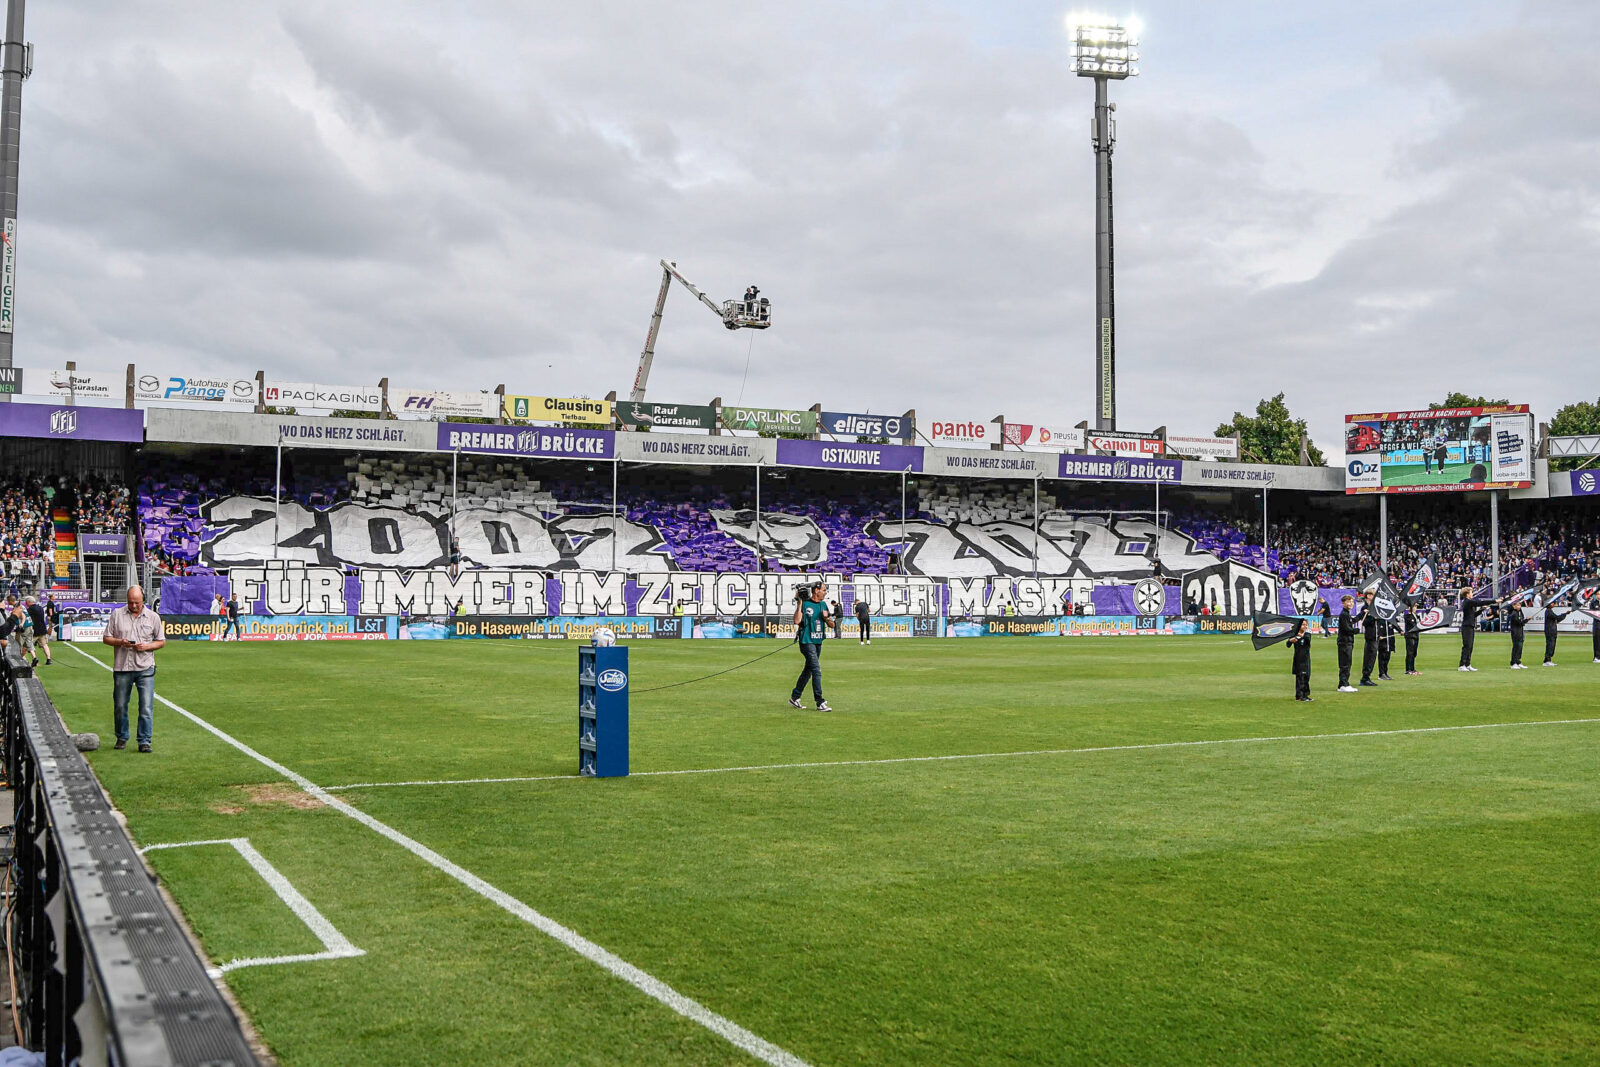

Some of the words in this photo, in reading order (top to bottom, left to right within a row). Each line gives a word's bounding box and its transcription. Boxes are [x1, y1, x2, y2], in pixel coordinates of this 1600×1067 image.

[164, 377, 226, 399] Prange
[187, 379, 228, 389] Autohaus
[282, 390, 379, 405] PACKAGING
[404, 396, 434, 409] FH
[544, 398, 603, 415] Clausing
[653, 406, 678, 415] Rauf
[561, 413, 587, 421] Tiefbau
[736, 410, 801, 424] DARLING
[1409, 411, 1435, 419] DENKEN
[1435, 409, 1456, 417] NACH!
[833, 416, 882, 435] ellers
[932, 421, 985, 440] pante
[279, 425, 297, 438] WO
[300, 425, 323, 439] DAS
[325, 426, 353, 440] HERZ
[356, 426, 407, 442] SCHLÄGT.
[1053, 432, 1078, 440] neusta
[450, 431, 515, 450] BREMER
[541, 432, 604, 454] BRÜCKE
[642, 441, 659, 453] WO
[660, 442, 679, 454] DAS
[681, 443, 705, 455] HERZ
[707, 443, 751, 458] SCHLÄGT.
[1092, 438, 1137, 451] Canon
[1143, 440, 1159, 454] brg
[821, 448, 881, 466] OSTKURVE
[946, 456, 960, 467] WO
[961, 456, 978, 468] DAS
[979, 457, 999, 469] HERZ
[1000, 457, 1037, 471] SCHLÄGT.
[1065, 461, 1112, 477] BREMER
[1130, 462, 1175, 480] BRÜCKE
[1201, 468, 1212, 479] WO
[1212, 469, 1227, 480] DAS
[1228, 470, 1246, 481] HERZ
[1246, 470, 1277, 482] SCHLÄGT.
[1351, 463, 1379, 475] noz
[1397, 484, 1475, 492] www.waldbach-logistik.de
[228, 559, 347, 616] FÜR
[358, 568, 550, 617] IMMER
[560, 570, 627, 617] IM
[853, 573, 938, 617] DER
[948, 575, 1095, 617] MASKE
[250, 621, 324, 634] Osnabrück
[327, 621, 349, 634] bei
[356, 618, 385, 632] L&T
[456, 621, 477, 635] Die
[480, 621, 546, 635] Hasewelle
[549, 621, 560, 634] in
[631, 621, 649, 634] bei
[655, 618, 681, 632] L&T
[743, 621, 761, 634] Die
[893, 621, 910, 633] bei
[914, 618, 935, 631] L&T
[989, 621, 1005, 634] Die
[1007, 621, 1055, 634] Hasewelle
[1058, 620, 1067, 632] in
[1069, 620, 1117, 632] Osnabrück
[1119, 619, 1132, 631] bei
[1136, 617, 1155, 629] L&T
[1200, 619, 1215, 631] Die
[1216, 619, 1254, 631] Hasewell
[273, 633, 298, 641] JOPA
[303, 633, 328, 641] JOPA
[361, 633, 386, 641] JOPA
[527, 632, 543, 640] bwin
